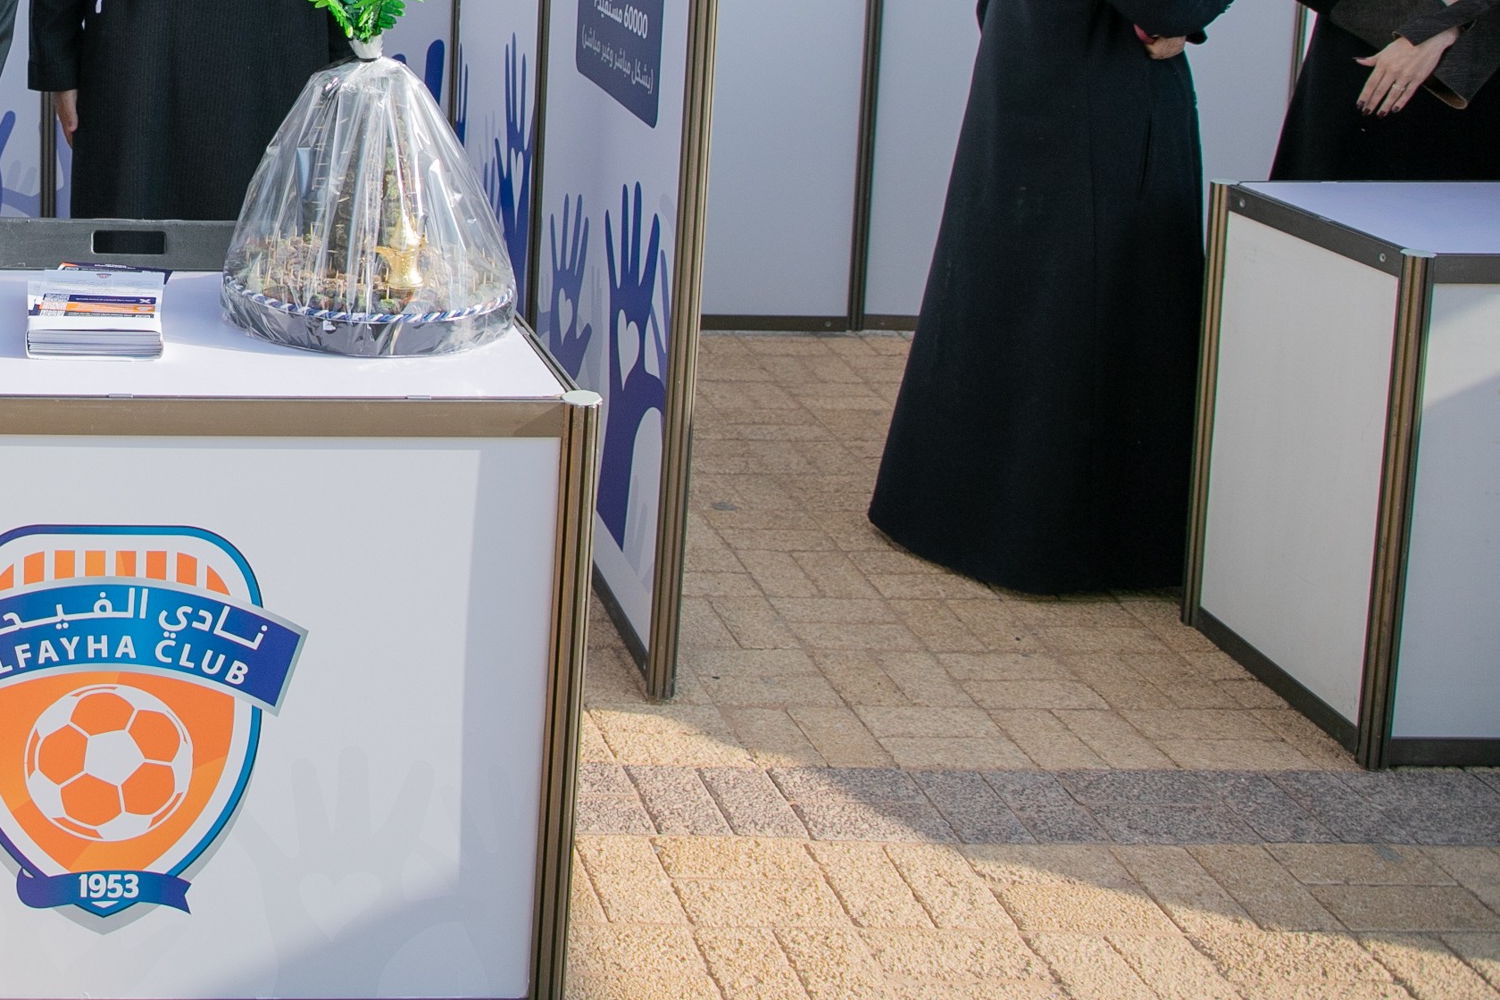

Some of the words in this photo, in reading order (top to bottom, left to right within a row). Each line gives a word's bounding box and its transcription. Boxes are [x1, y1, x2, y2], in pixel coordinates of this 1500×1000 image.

[623, 3, 649, 40] 60000
[158, 604, 268, 651] نادي
[154, 637, 250, 686] CLUB
[78, 873, 140, 899] 1953
